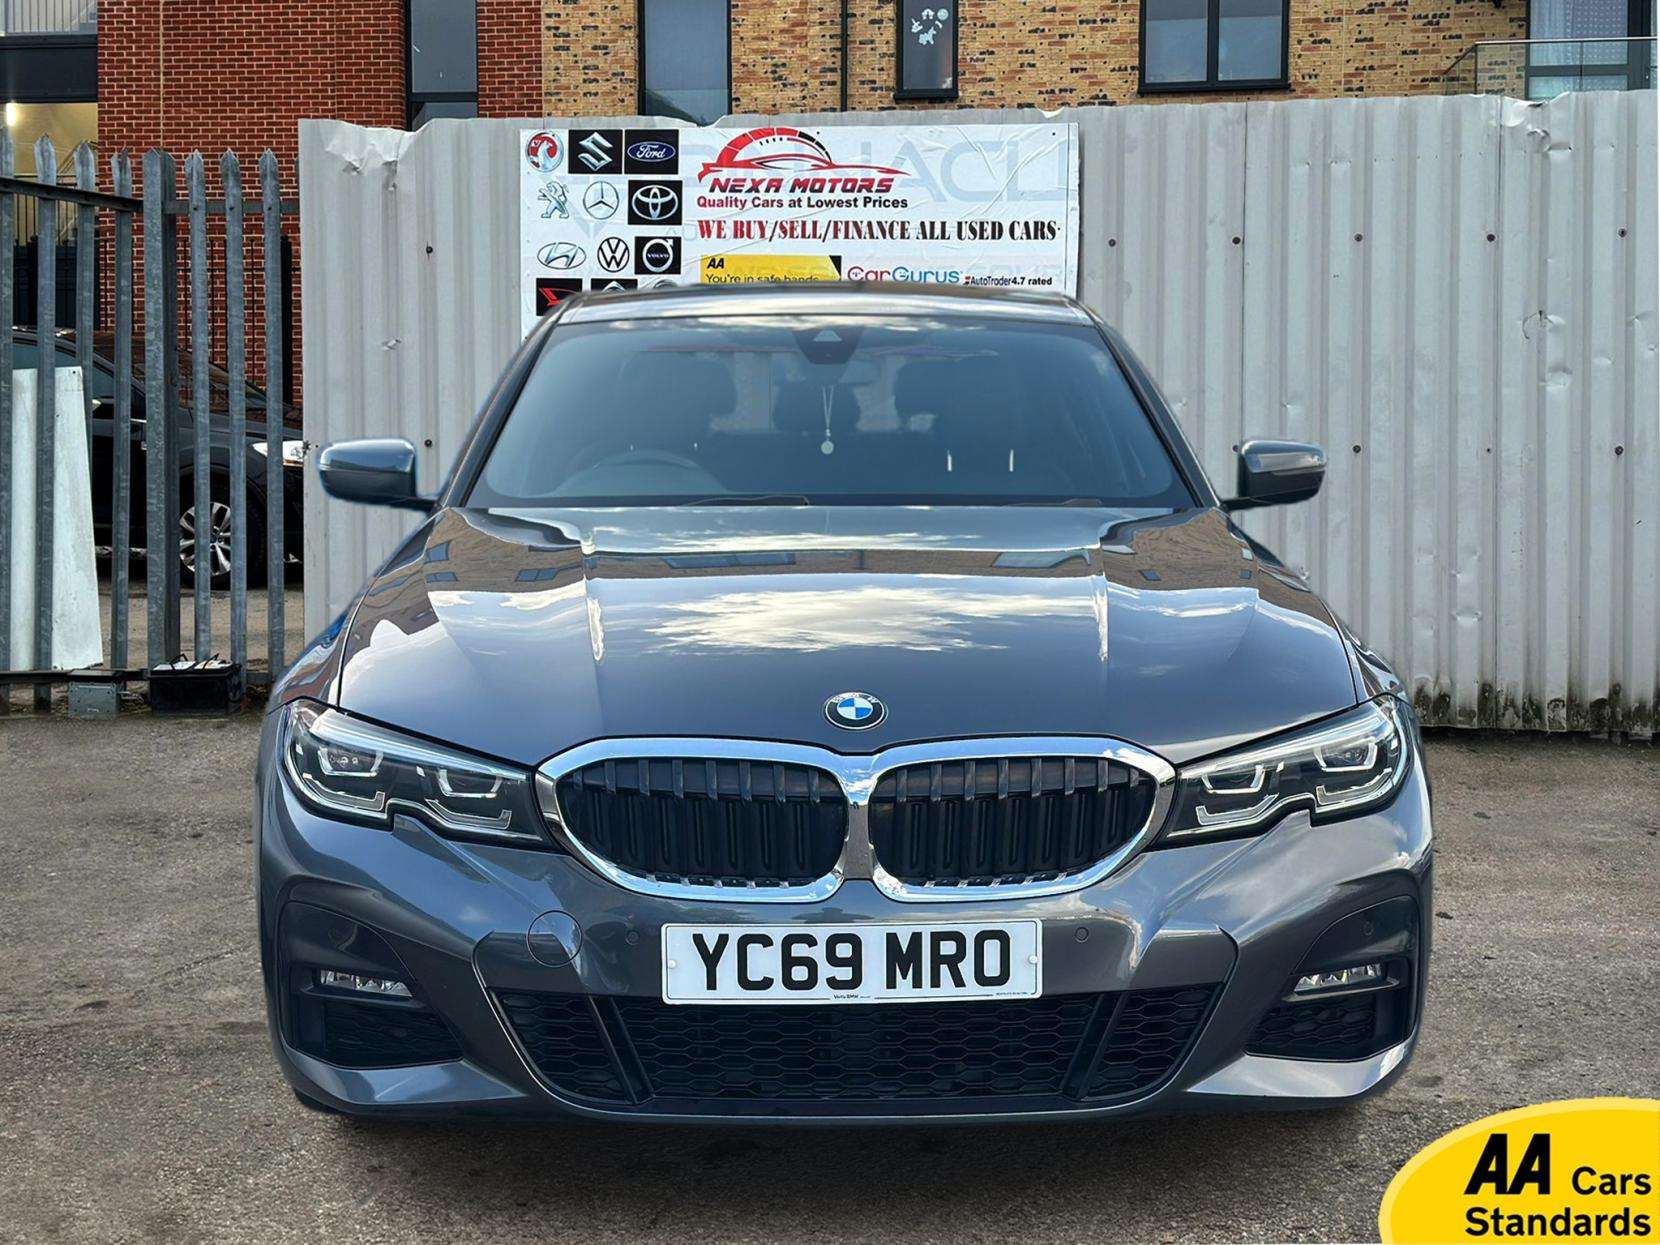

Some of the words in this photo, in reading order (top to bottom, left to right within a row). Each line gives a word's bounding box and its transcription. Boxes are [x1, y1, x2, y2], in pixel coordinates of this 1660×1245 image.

[636, 144, 666, 158] Ford
[708, 177, 784, 194] NEXA
[789, 177, 895, 194] MOTORS
[697, 196, 747, 211] Quality
[751, 196, 784, 208] Cars
[788, 196, 803, 208] at
[806, 196, 859, 208] Lowest
[863, 196, 908, 209] Prices
[697, 220, 727, 240] WE
[916, 220, 951, 240] ALL
[956, 220, 1004, 240] USED
[706, 257, 725, 269] AA
[706, 273, 741, 284] You're
[847, 266, 960, 284] CarGurus
[1028, 276, 1053, 286] rated
[692, 932, 863, 991] YC69
[885, 929, 1011, 989] MRO
